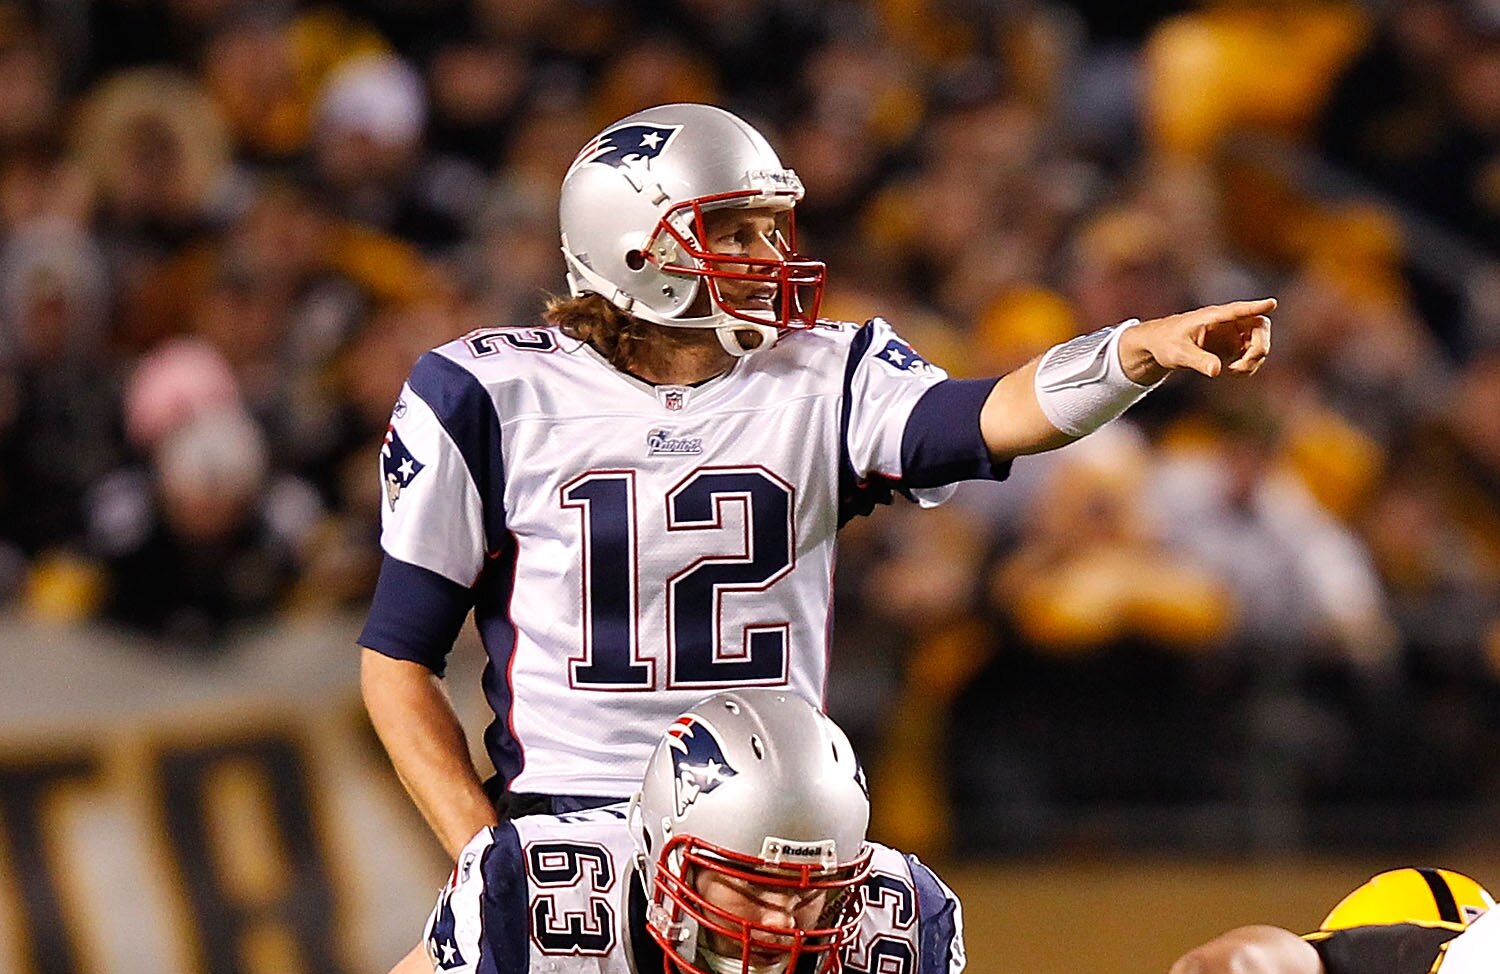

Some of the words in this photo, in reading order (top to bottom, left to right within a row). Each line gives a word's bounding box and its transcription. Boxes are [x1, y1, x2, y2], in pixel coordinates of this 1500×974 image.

[560, 464, 797, 691] 12
[525, 840, 617, 957] 63
[782, 845, 822, 856] Riddell
